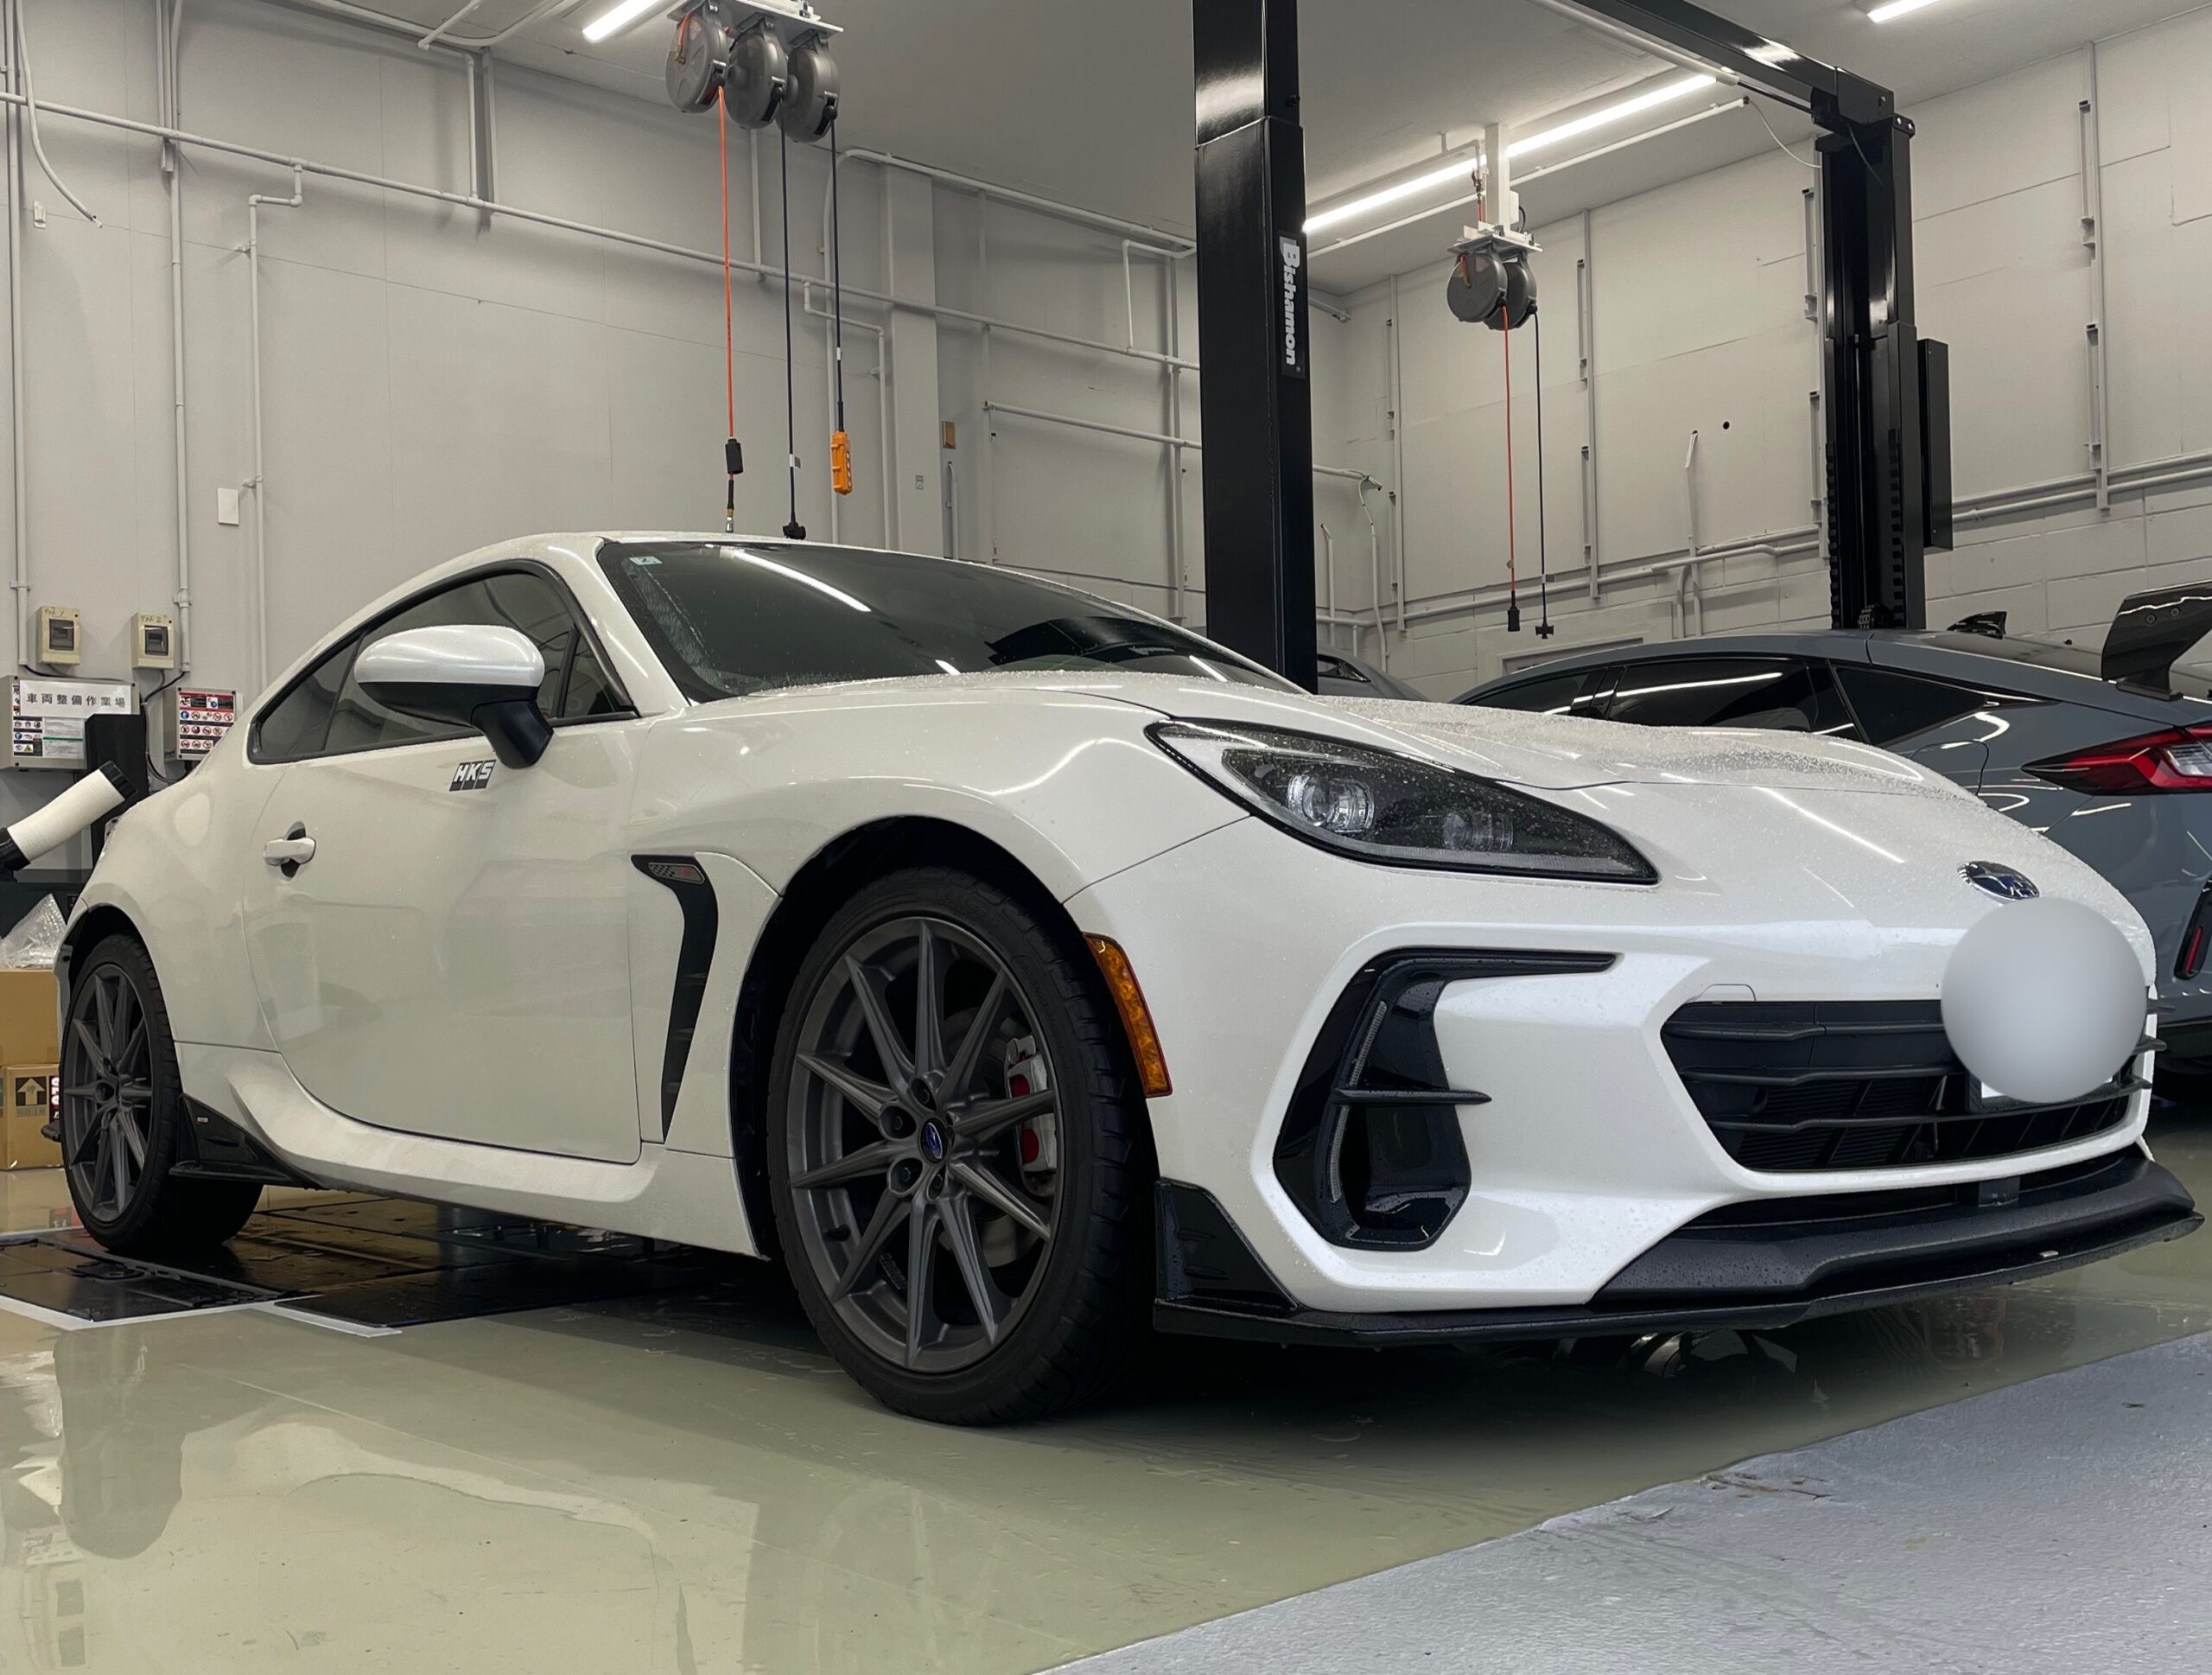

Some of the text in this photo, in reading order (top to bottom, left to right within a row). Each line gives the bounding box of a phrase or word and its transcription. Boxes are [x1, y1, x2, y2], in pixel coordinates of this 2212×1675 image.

[1283, 242, 1300, 366] Bishamon
[26, 692, 126, 709] 車両整備作業場
[453, 761, 495, 783] HKS
